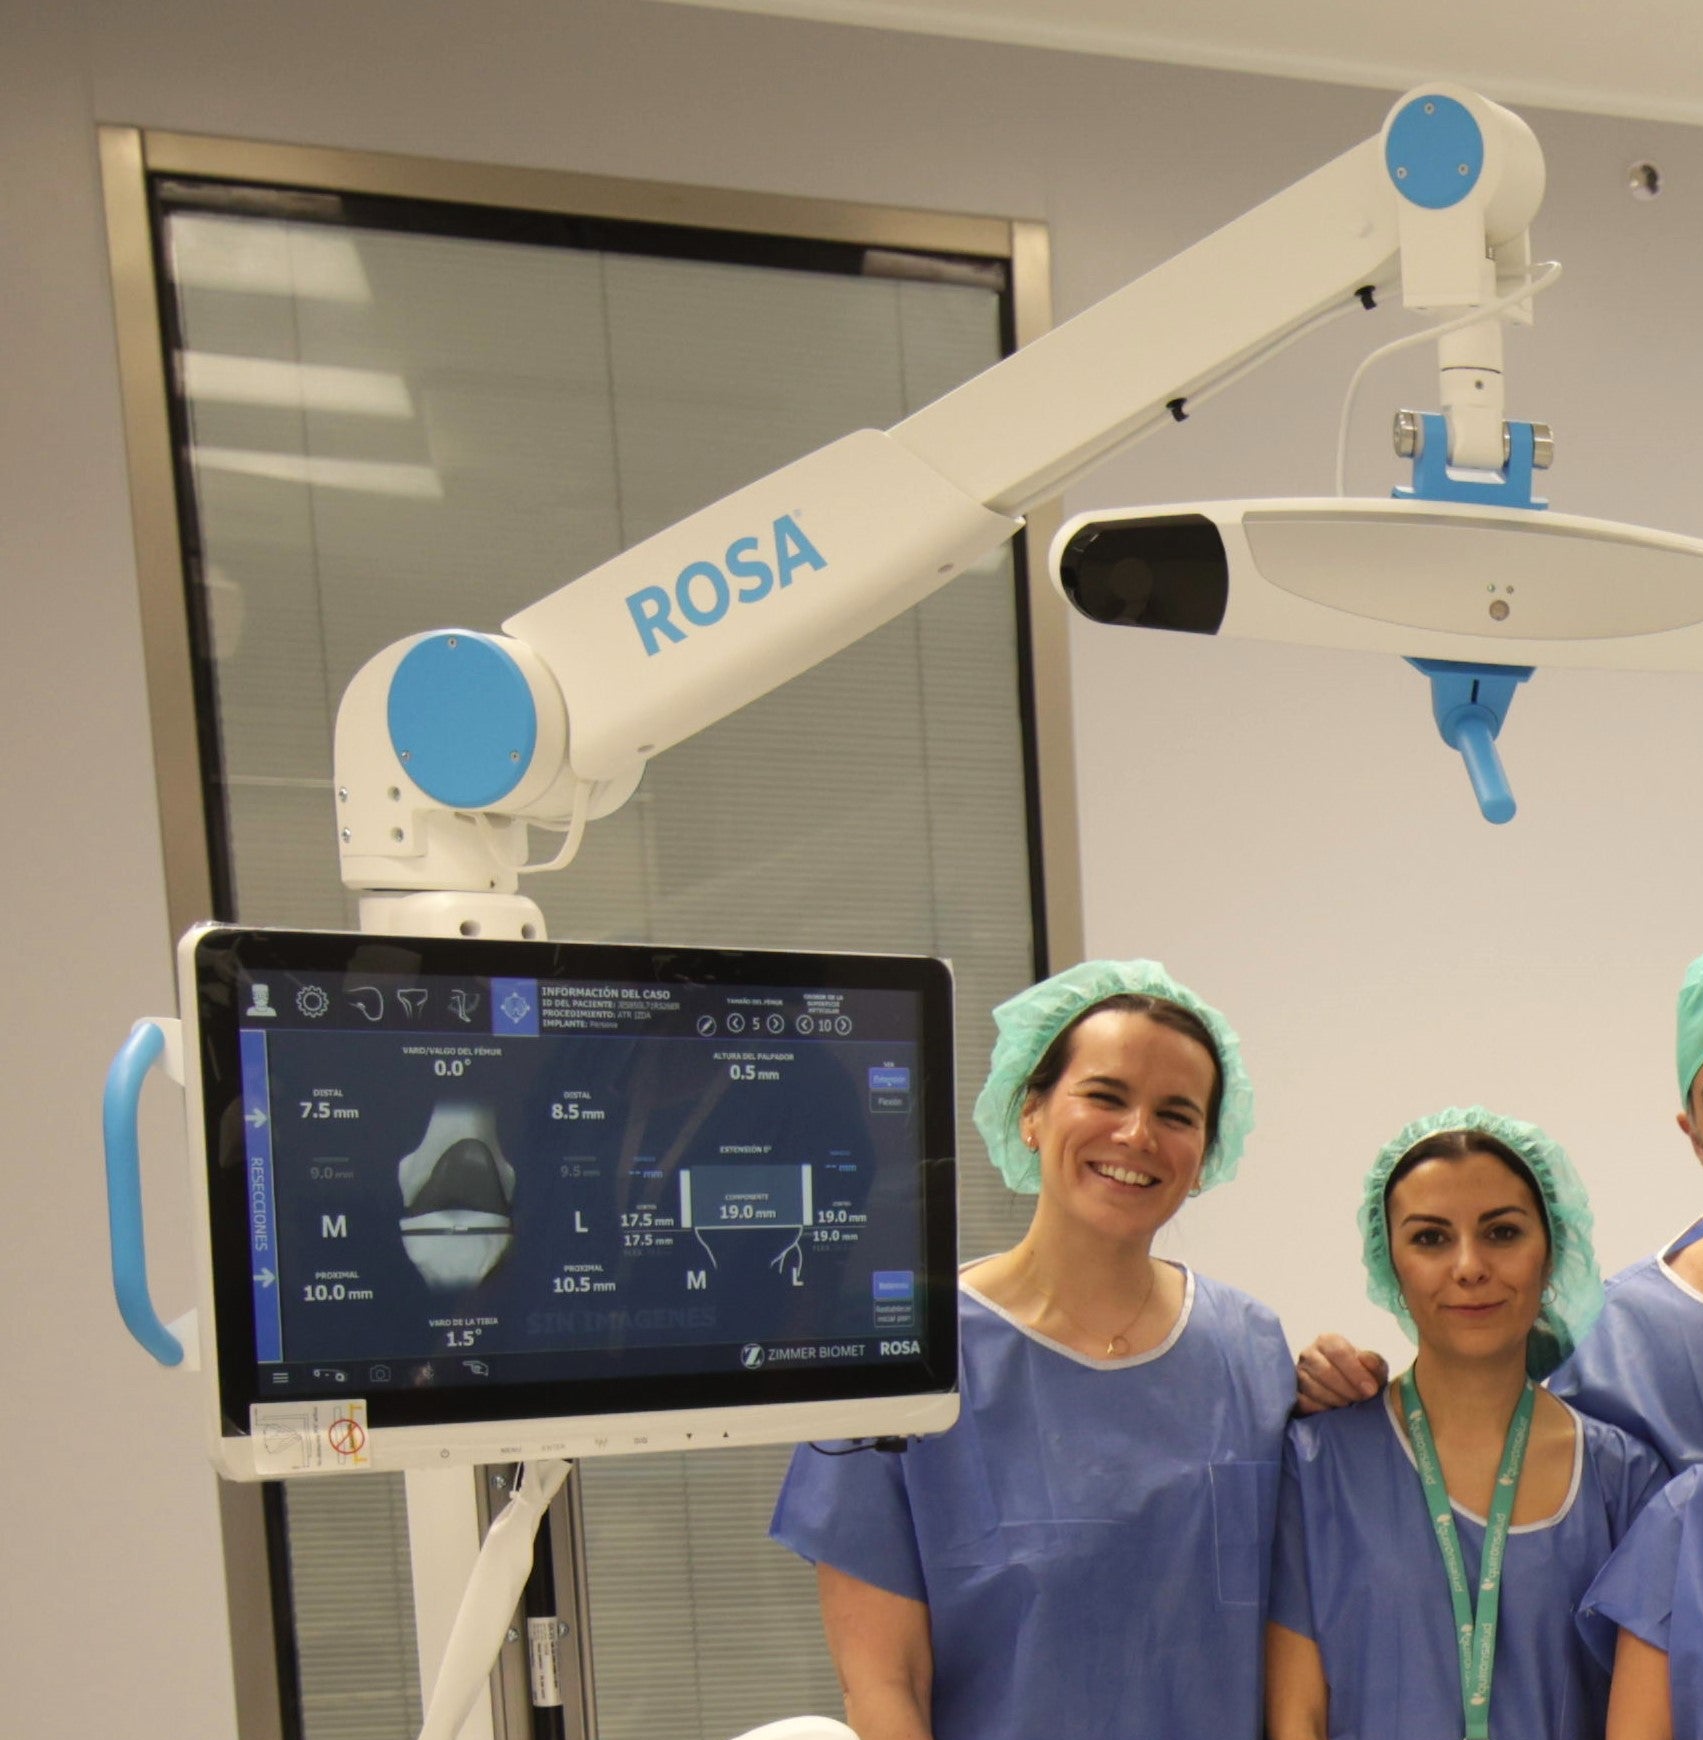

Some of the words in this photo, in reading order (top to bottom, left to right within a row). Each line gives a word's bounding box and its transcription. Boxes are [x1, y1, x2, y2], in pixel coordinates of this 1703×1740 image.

[625, 514, 828, 657] ROSA
[542, 986, 618, 1000] INFORMACIÓN
[620, 988, 641, 1000] DEL
[643, 989, 671, 1000] CASO
[555, 1000, 570, 1009] DEL
[751, 1017, 760, 1031] 5
[818, 1019, 832, 1033] 10
[729, 1064, 756, 1080] 0.5
[757, 1070, 780, 1081] mm
[313, 1088, 344, 1098] DISTAL
[300, 1102, 331, 1119] 7.5
[333, 1108, 359, 1119] mm
[551, 1103, 580, 1120] 8.5
[582, 1109, 605, 1120] mm
[310, 1167, 333, 1180] 9.0
[560, 1166, 582, 1178] 9.5
[250, 1157, 269, 1252] RESECCIONES
[720, 1205, 753, 1219] 19.0
[755, 1210, 776, 1219] mm
[575, 1211, 589, 1233] L
[621, 1213, 652, 1227] 17.5
[654, 1217, 675, 1227] mm
[818, 1210, 847, 1223] 19.0
[849, 1214, 867, 1223] mm
[321, 1215, 347, 1238] M
[624, 1234, 653, 1247] 17.5
[813, 1230, 840, 1242] 19.0
[687, 1270, 707, 1290] M
[792, 1267, 804, 1286] L
[304, 1285, 345, 1301] 10.0
[348, 1289, 373, 1300] mm
[553, 1277, 590, 1293] 10.5
[593, 1281, 616, 1292] mm
[768, 1346, 817, 1361] ZIMMER
[819, 1344, 867, 1359] BIOMET
[880, 1340, 921, 1356] ROSA
